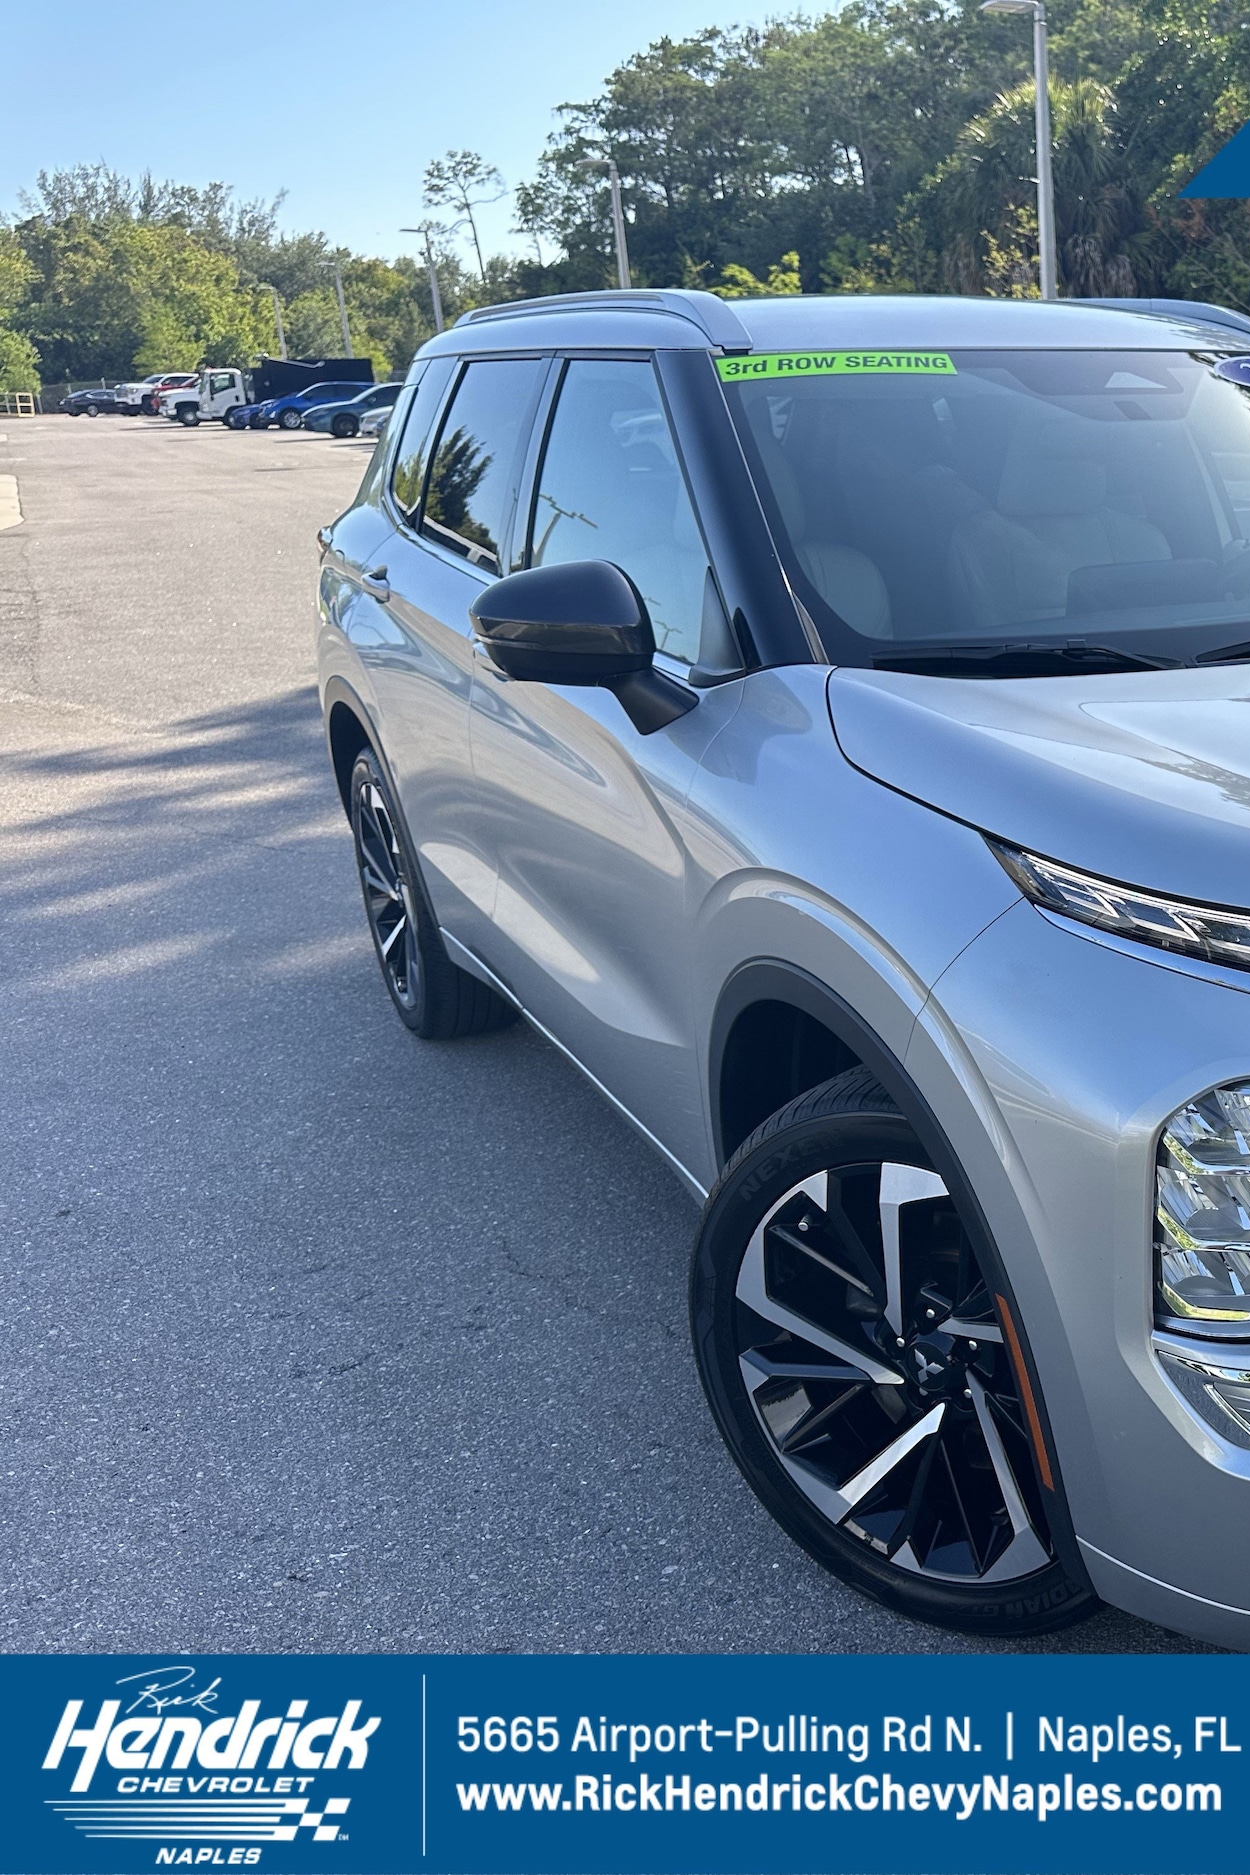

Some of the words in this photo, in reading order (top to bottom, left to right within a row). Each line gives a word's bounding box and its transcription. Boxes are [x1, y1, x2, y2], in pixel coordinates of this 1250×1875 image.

[725, 359, 767, 376] 3rd
[777, 356, 837, 371] ROW
[845, 356, 948, 369] SEATING
[738, 1128, 848, 1202] NEXEN
